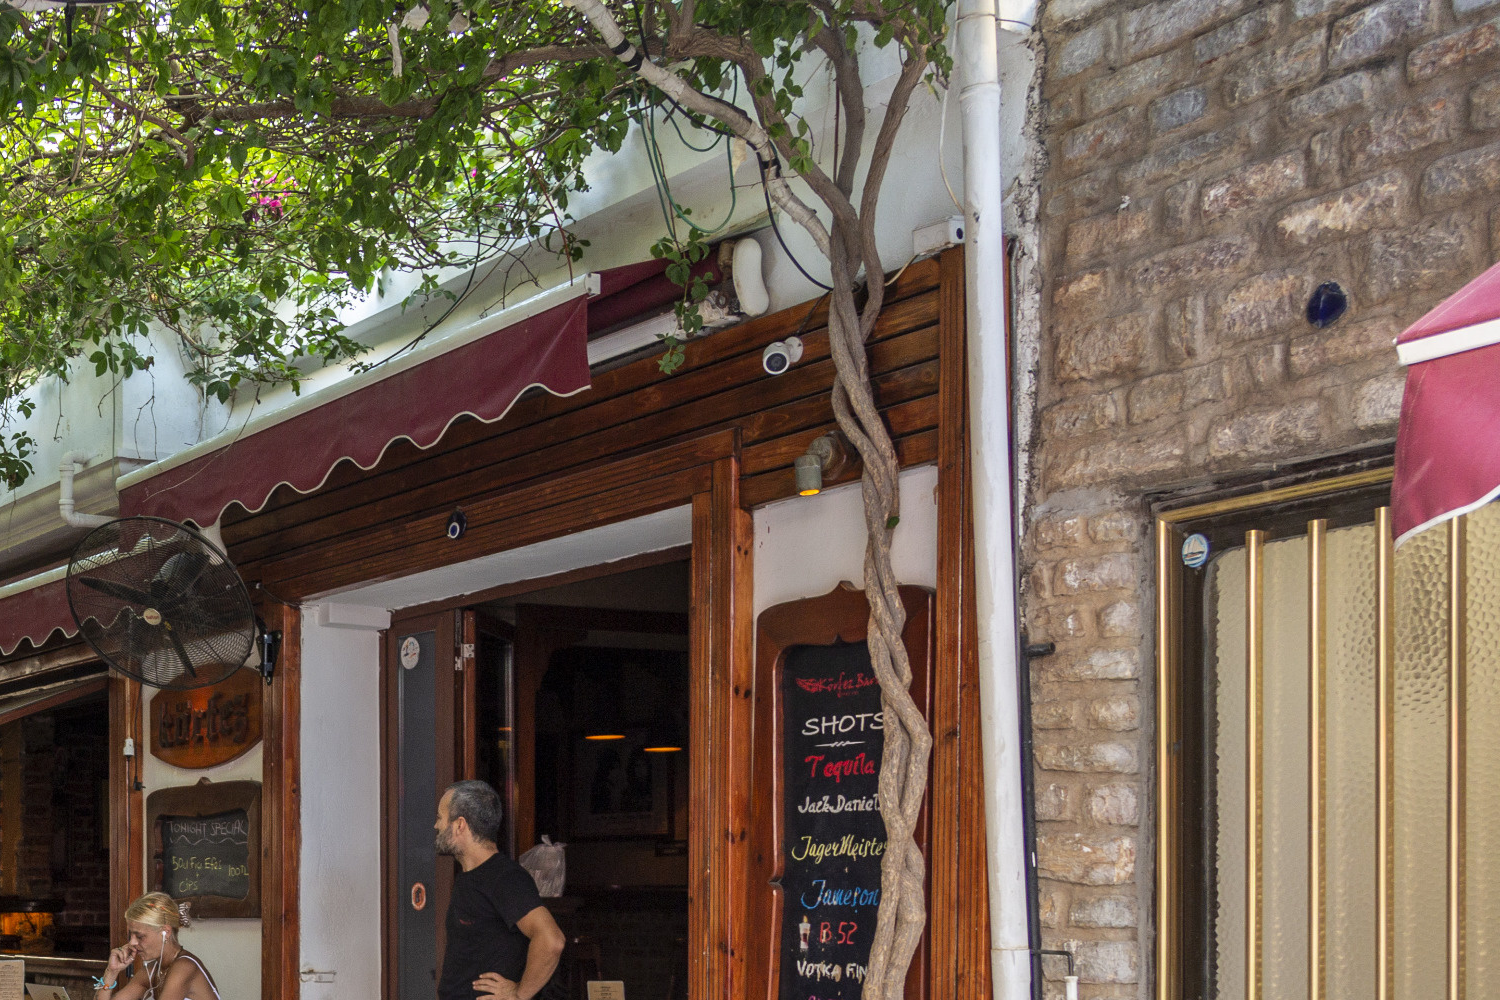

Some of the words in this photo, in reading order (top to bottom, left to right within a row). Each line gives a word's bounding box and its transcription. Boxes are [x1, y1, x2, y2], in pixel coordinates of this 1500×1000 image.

[802, 712, 883, 736] SHOTS
[804, 752, 875, 783] Tequila
[797, 795, 830, 814] Jack
[166, 821, 207, 838] TONIGHT
[801, 880, 880, 910] Jameson
[837, 922, 858, 945] 52
[797, 959, 842, 982] VOTKA
